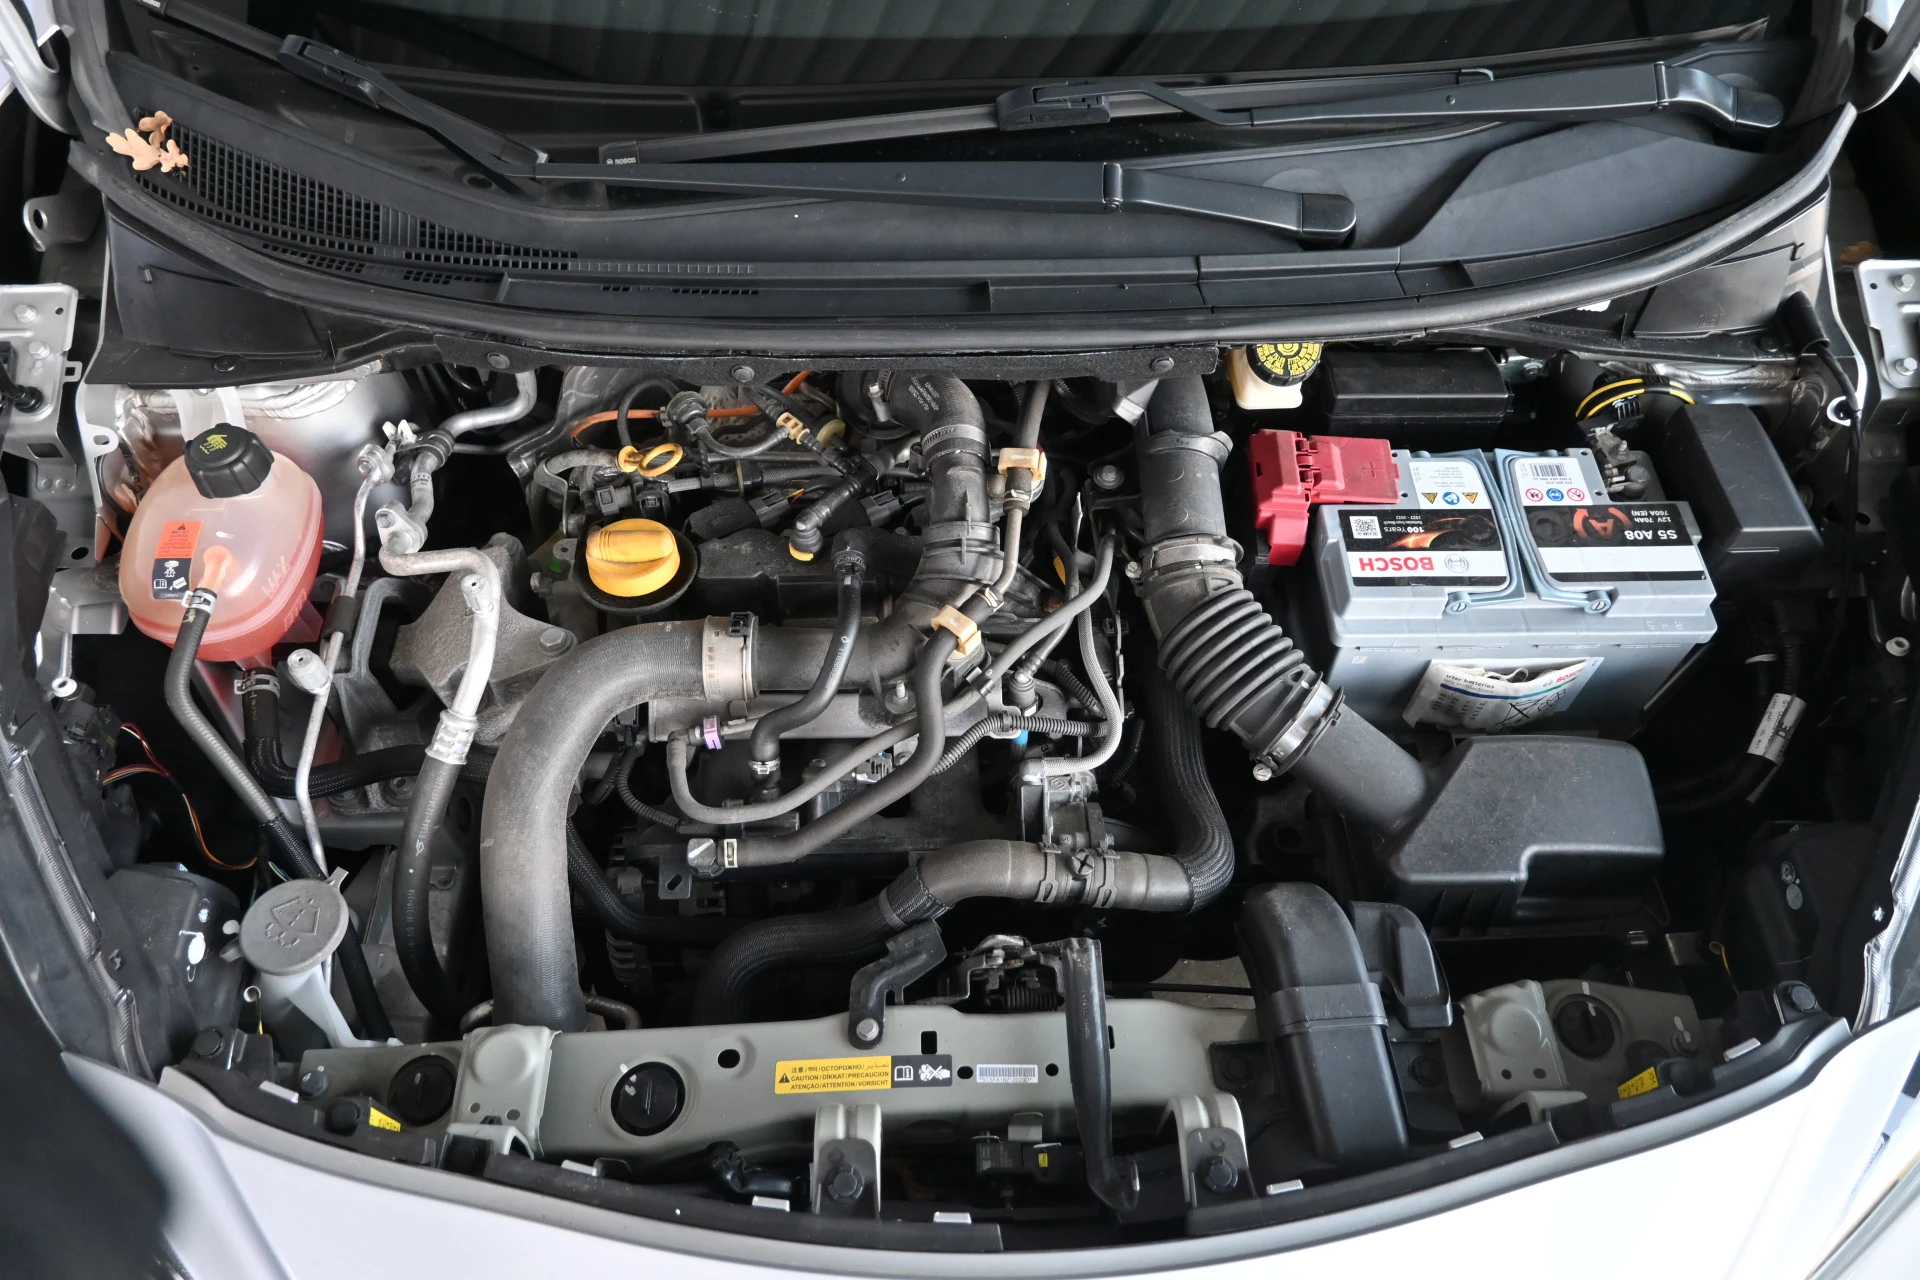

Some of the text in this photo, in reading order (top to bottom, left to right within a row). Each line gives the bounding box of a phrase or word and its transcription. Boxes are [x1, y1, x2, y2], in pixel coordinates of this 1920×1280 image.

[1624, 529, 1678, 540] S5 A08
[1358, 556, 1435, 572] BOSCH
[1463, 678, 1495, 689] batteries
[790, 1081, 819, 1090] ATENÇÃO
